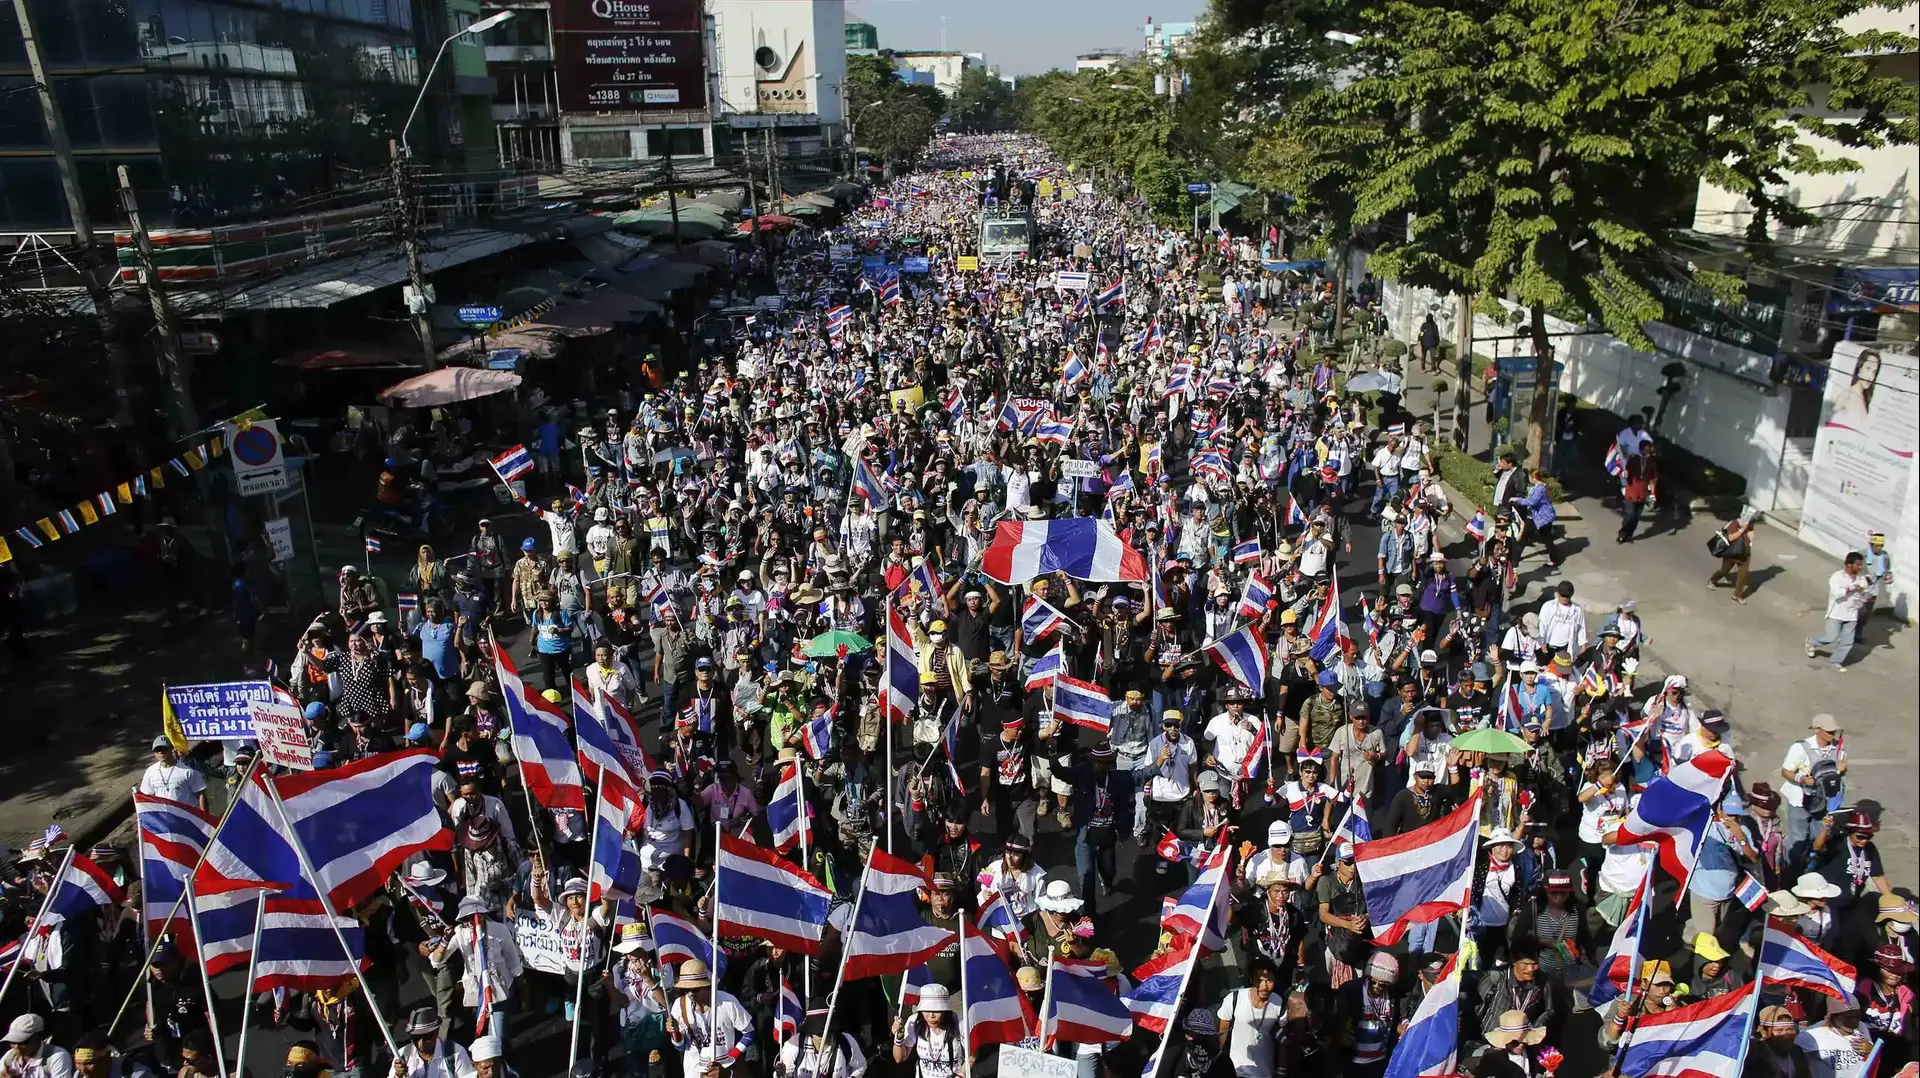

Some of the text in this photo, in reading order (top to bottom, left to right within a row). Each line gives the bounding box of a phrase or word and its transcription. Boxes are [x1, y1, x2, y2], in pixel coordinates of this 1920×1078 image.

[613, 1, 650, 12] House
[629, 38, 634, 47] 2
[635, 36, 645, 47] ไร่
[646, 38, 652, 47] 6
[655, 39, 671, 47] นอน
[612, 68, 652, 81] เริ่ม 27 ล้าน
[487, 307, 497, 317] 14
[242, 478, 286, 493] ตลอดเวลา
[188, 702, 250, 718] รักศักดิ์ศ
